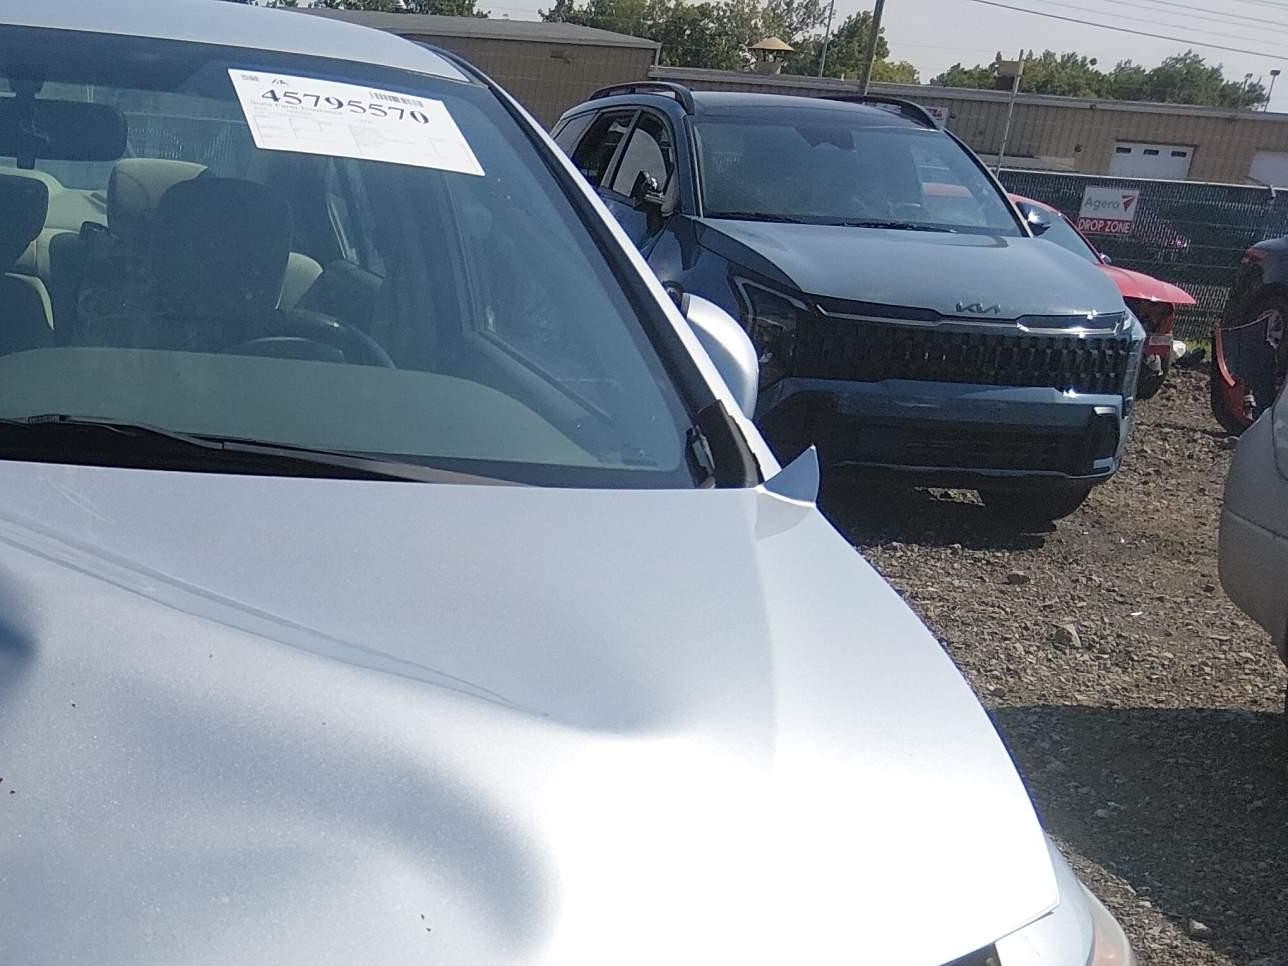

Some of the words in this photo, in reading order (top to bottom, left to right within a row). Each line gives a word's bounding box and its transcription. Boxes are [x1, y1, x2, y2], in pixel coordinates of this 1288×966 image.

[261, 88, 430, 125] 45795570
[1084, 196, 1120, 211] Agero
[1078, 218, 1104, 231] DROP
[1105, 220, 1130, 233] ZONE
